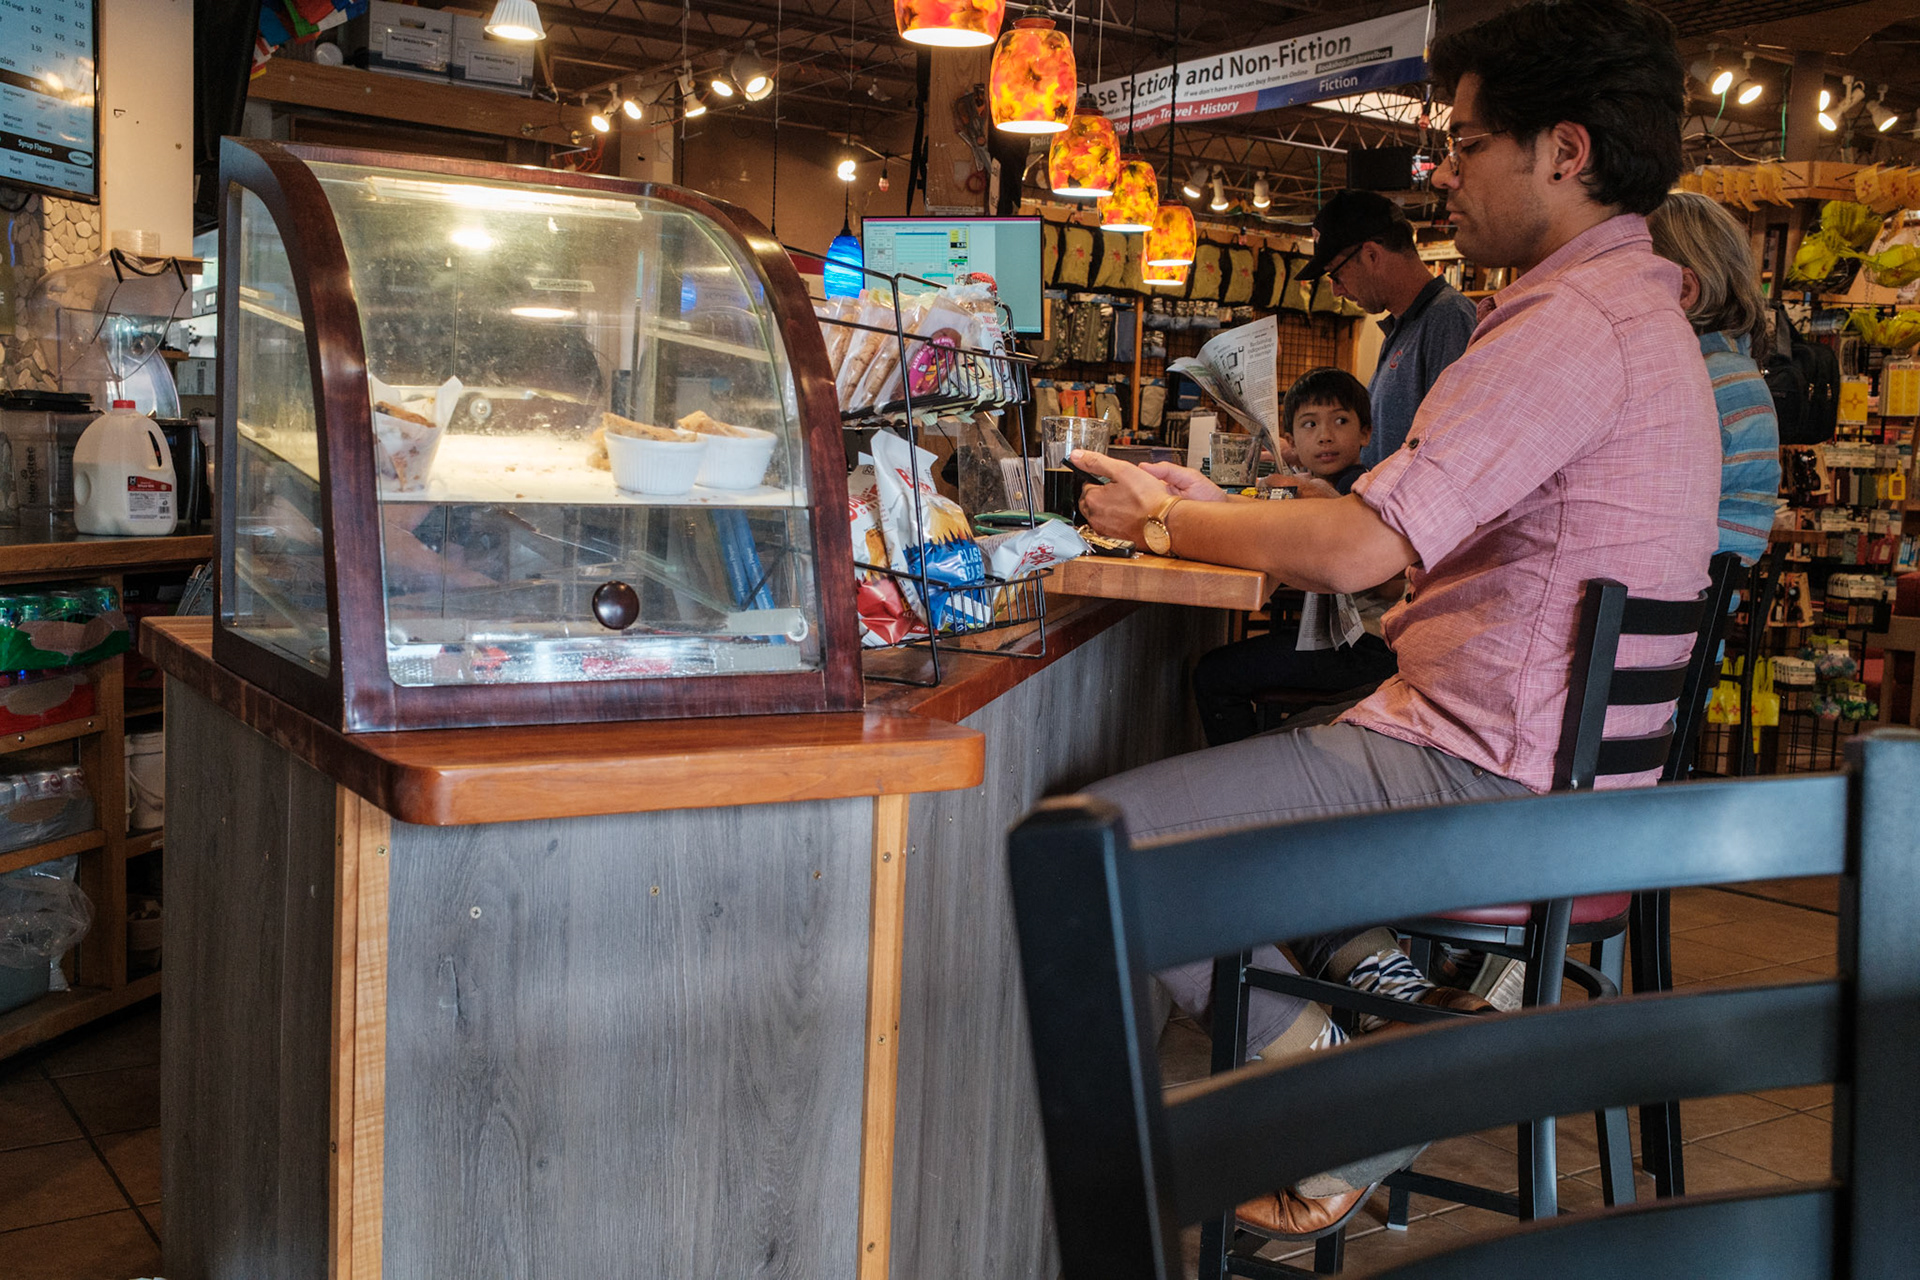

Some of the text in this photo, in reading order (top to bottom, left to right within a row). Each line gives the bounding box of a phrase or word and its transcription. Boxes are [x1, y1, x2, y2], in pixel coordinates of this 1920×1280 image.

[1099, 35, 1351, 107] se Fiction and Non-Fiction
[1189, 89, 1198, 97] we
[1199, 86, 1214, 96] don't
[1214, 84, 1228, 93] have
[1233, 81, 1244, 91] you
[1244, 80, 1255, 88] can
[1255, 77, 1267, 86] buy
[1267, 73, 1282, 82] from
[1289, 68, 1309, 78] Online
[1318, 75, 1359, 93] Fiction
[1141, 99, 1148, 107] 12
[1160, 105, 1193, 119] Travel
[1200, 100, 1240, 115] History
[17, 138, 53, 154] Syrup Flavors
